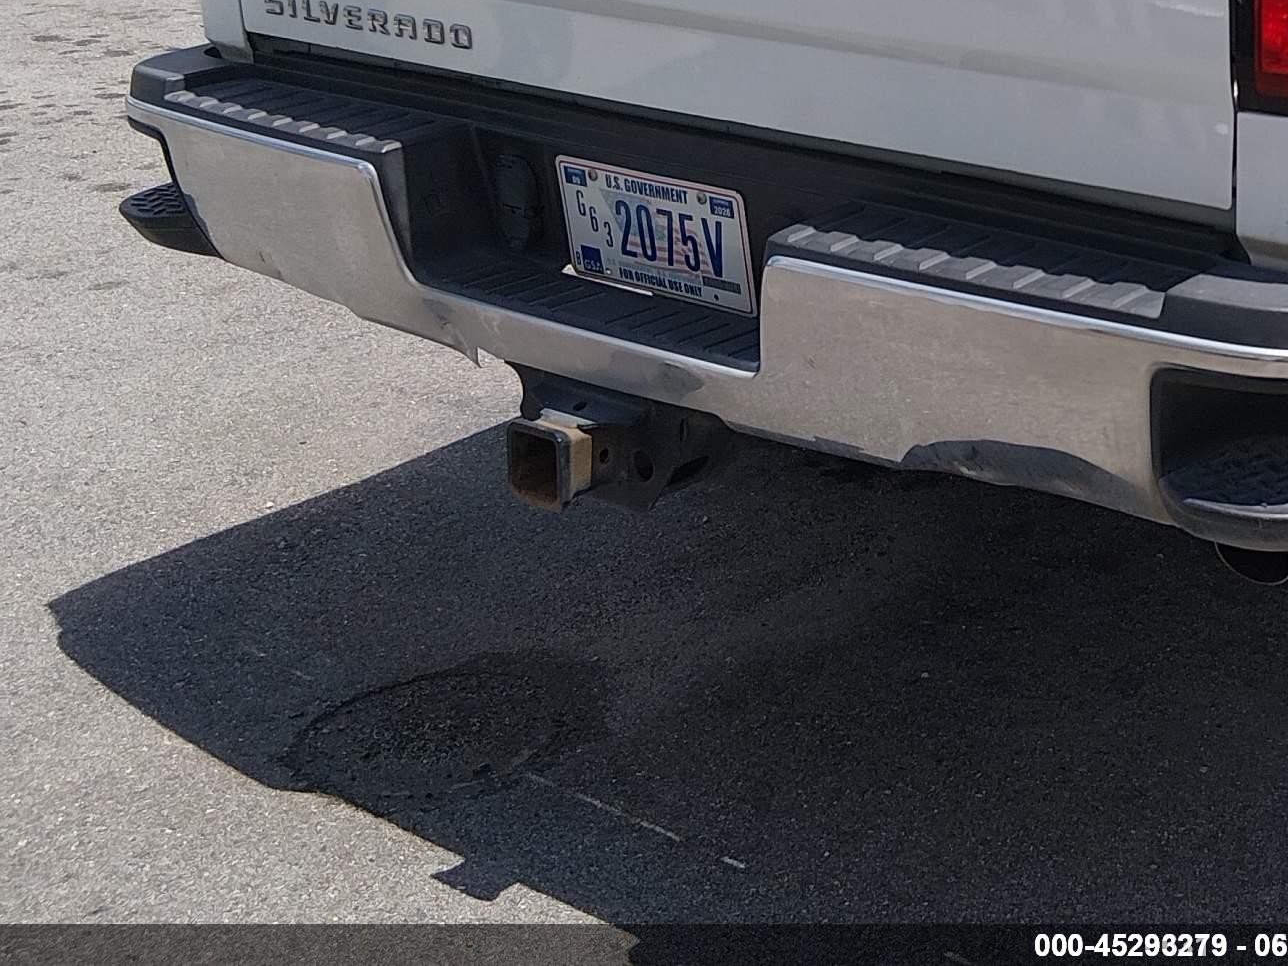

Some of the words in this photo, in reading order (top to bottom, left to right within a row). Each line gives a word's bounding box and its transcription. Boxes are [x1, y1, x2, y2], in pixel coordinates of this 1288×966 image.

[605, 174, 623, 190] U.S.
[624, 178, 688, 204] GOVERNMENT
[615, 199, 724, 278] 2075V
[619, 267, 634, 281] FOR
[634, 270, 668, 289] OFFICIAL
[668, 278, 684, 293] USE
[684, 281, 703, 298] ONLY
